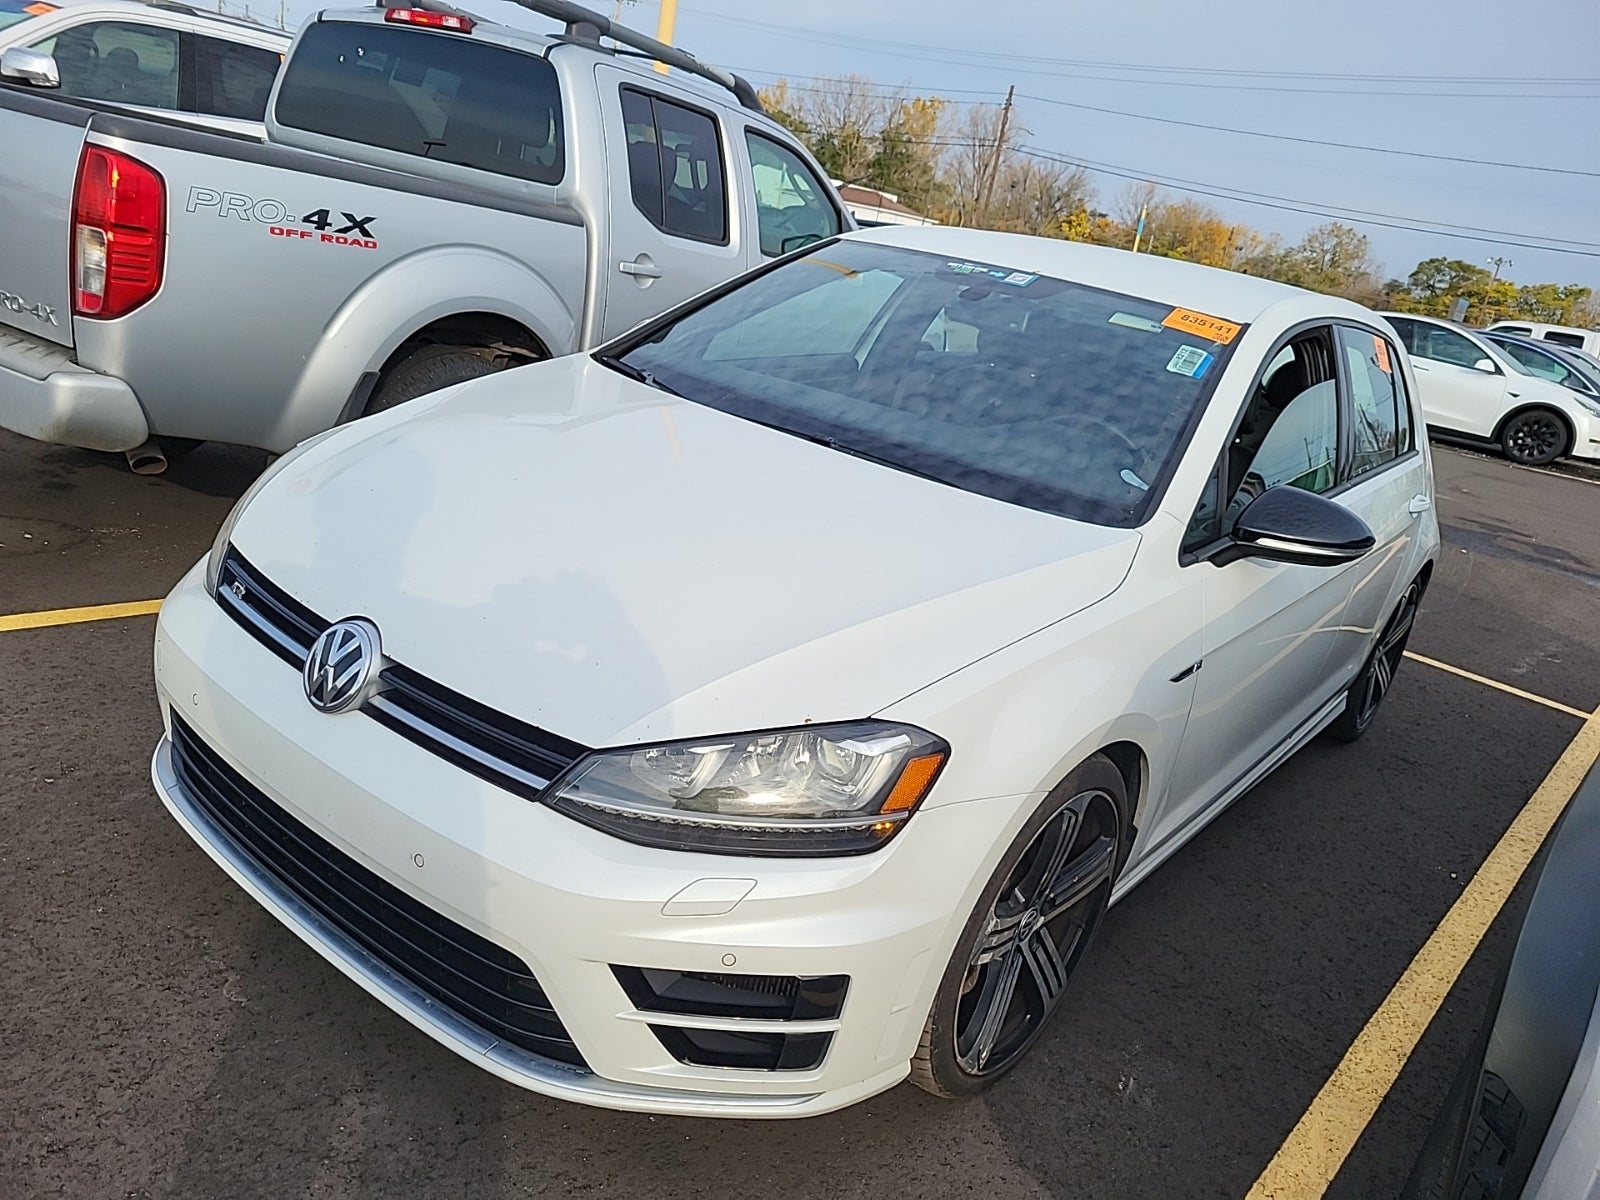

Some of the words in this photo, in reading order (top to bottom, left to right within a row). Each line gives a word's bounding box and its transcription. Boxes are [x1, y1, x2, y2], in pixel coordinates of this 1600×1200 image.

[269, 226, 313, 239] OFF
[320, 233, 378, 250] ROAD
[1180, 314, 1232, 334] 835141
